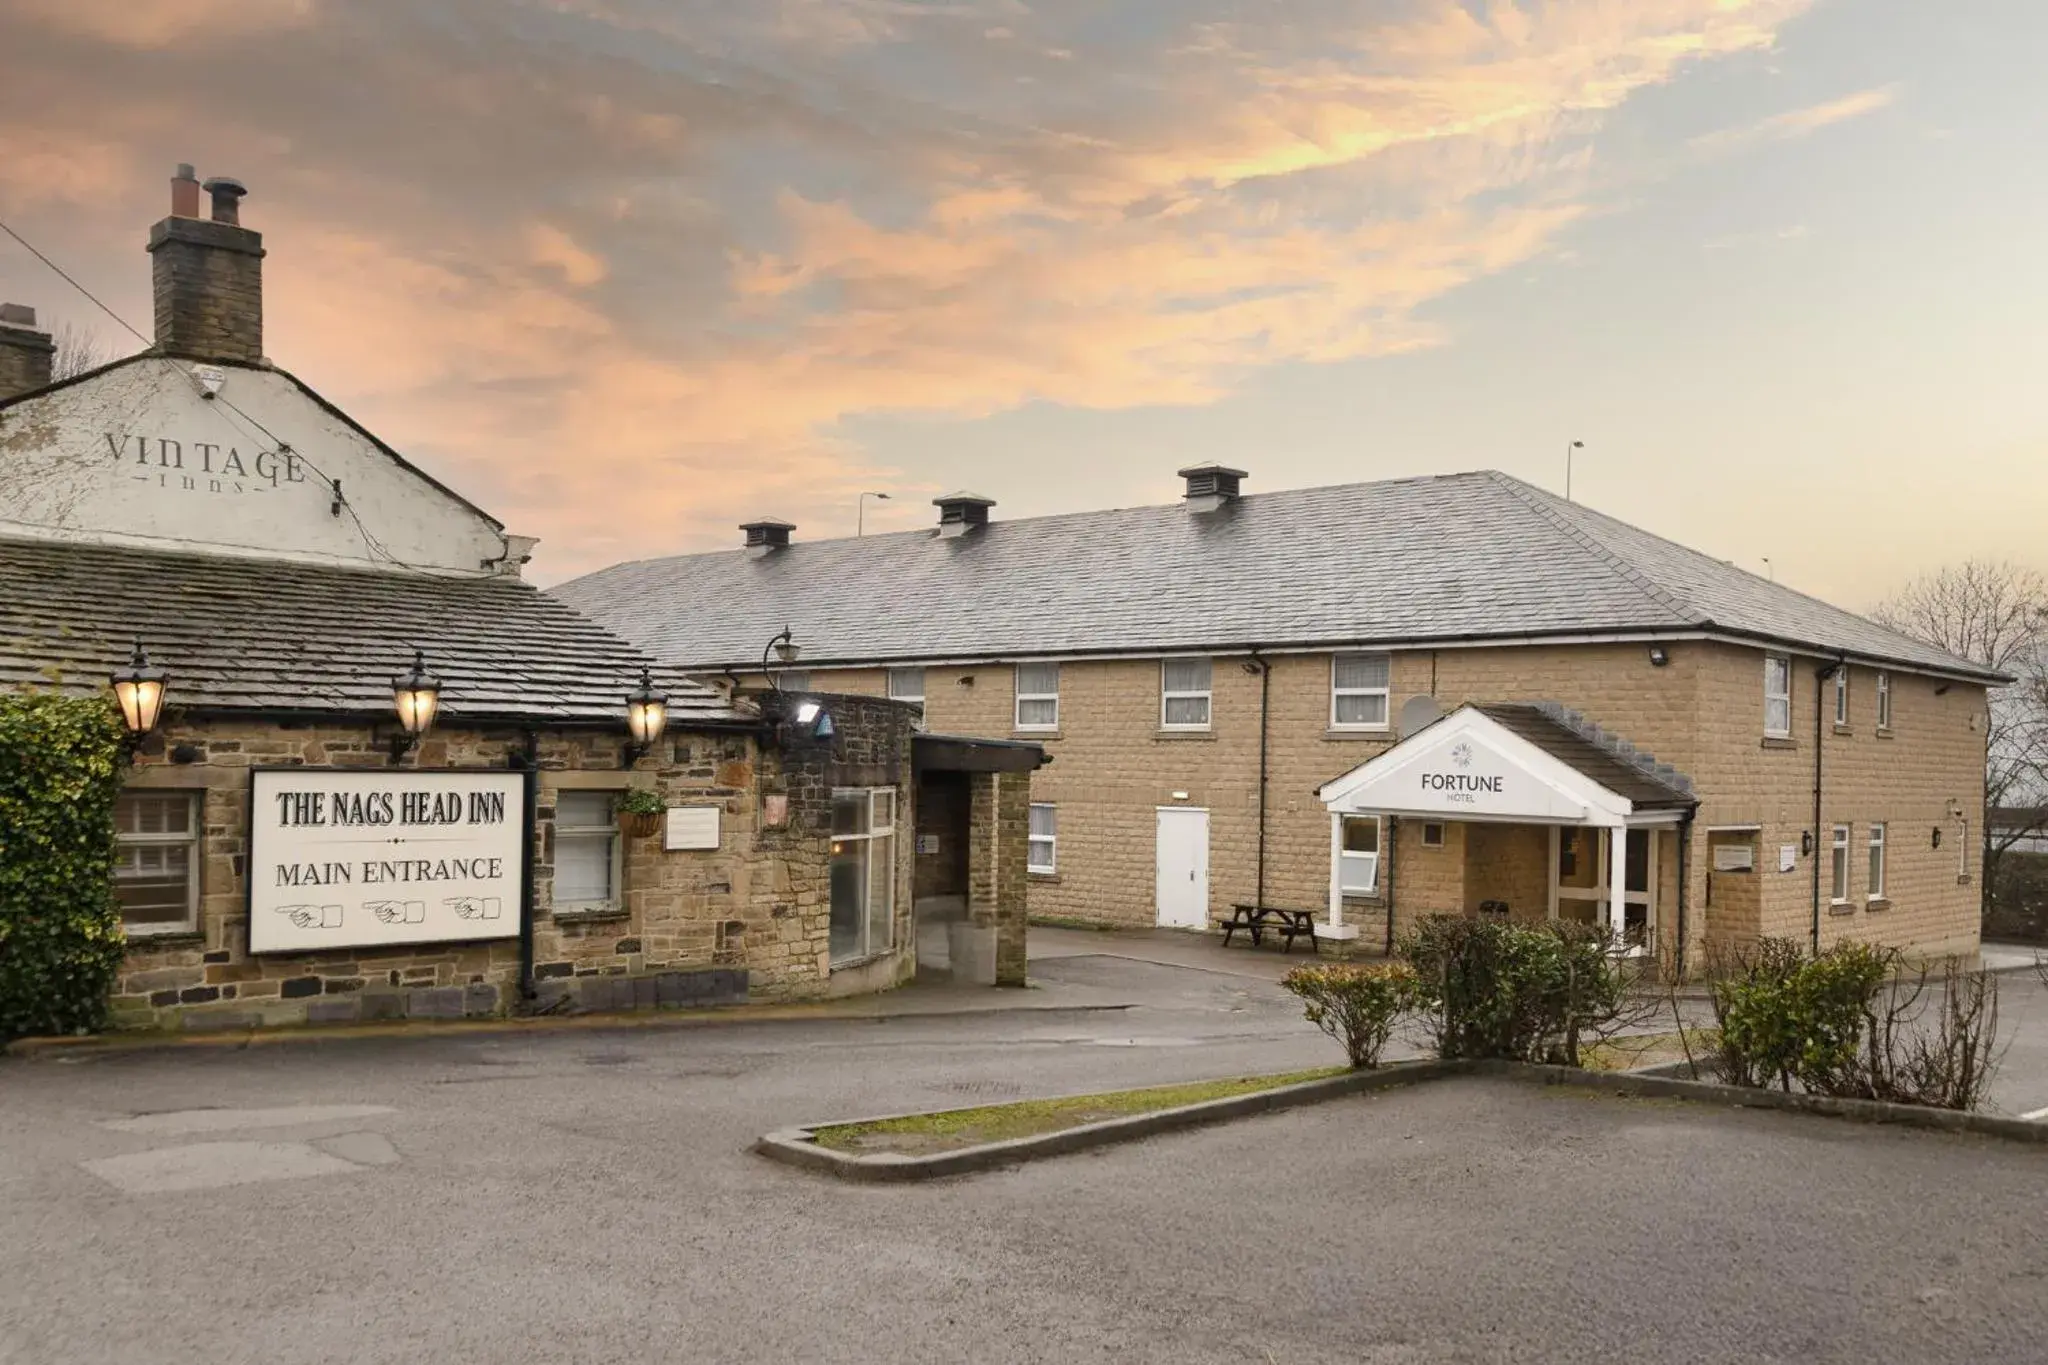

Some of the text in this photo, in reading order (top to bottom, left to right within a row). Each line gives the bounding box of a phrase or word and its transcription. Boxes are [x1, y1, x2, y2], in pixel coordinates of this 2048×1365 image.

[1421, 773, 1504, 793] FORTUNE
[275, 791, 506, 827] THE NAGS HEAD INN
[1447, 793, 1475, 803] HOTEL
[275, 857, 503, 887] MAIN ENTRANCE
